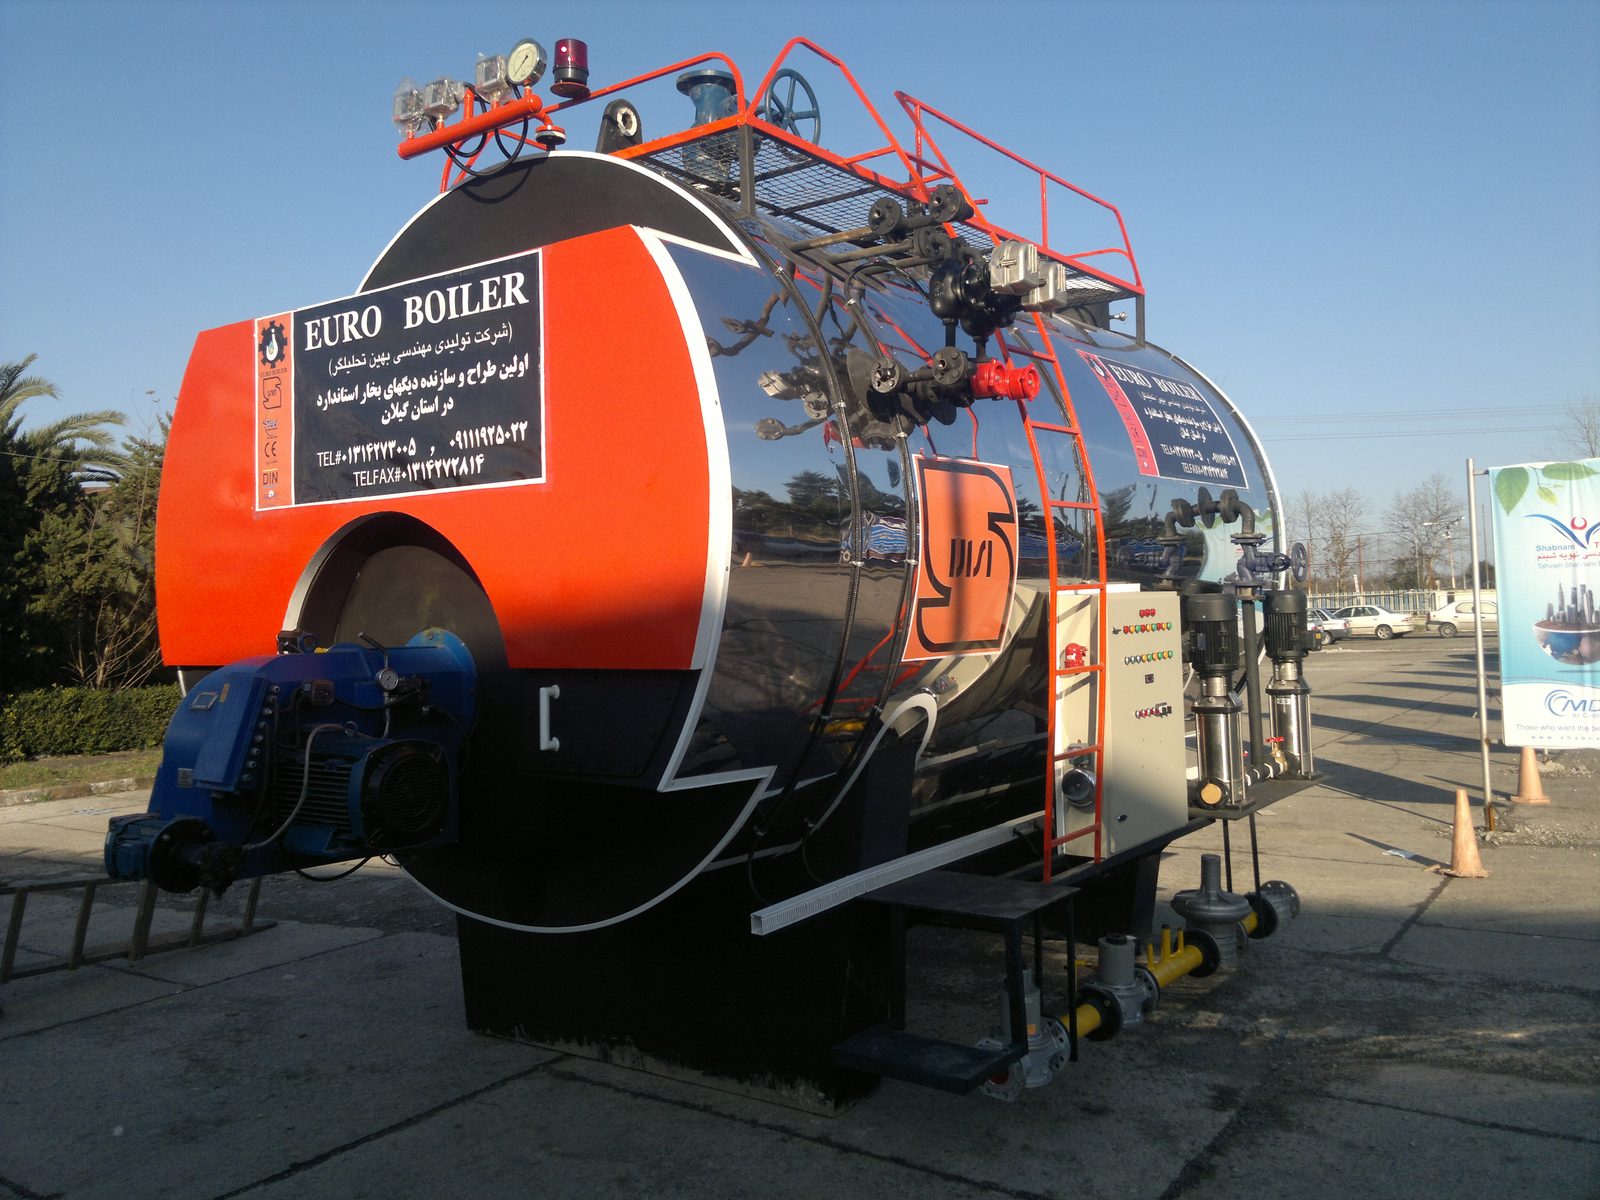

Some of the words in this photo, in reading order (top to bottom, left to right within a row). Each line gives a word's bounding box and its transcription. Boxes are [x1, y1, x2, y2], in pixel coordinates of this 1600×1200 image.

[304, 305, 383, 351] EURO
[403, 271, 530, 330] BOILER
[393, 341, 432, 365] مهندسی
[435, 331, 471, 355] تولیدی
[466, 359, 497, 386] طراح
[499, 352, 530, 381] اولین
[420, 367, 456, 392] سازنده
[457, 373, 465, 388] و
[1108, 363, 1152, 389] EURO
[1151, 376, 1203, 402] BOILER
[316, 384, 359, 411] استاندارد
[360, 381, 382, 405] بخار
[381, 400, 410, 425] گیلان
[410, 396, 439, 420] استان
[440, 395, 455, 417] در
[264, 441, 278, 458] CE
[263, 472, 279, 485] DIN
[1536, 544, 1576, 552] Shabnam
[1516, 723, 1539, 731] Those
[1577, 725, 1589, 733] the
